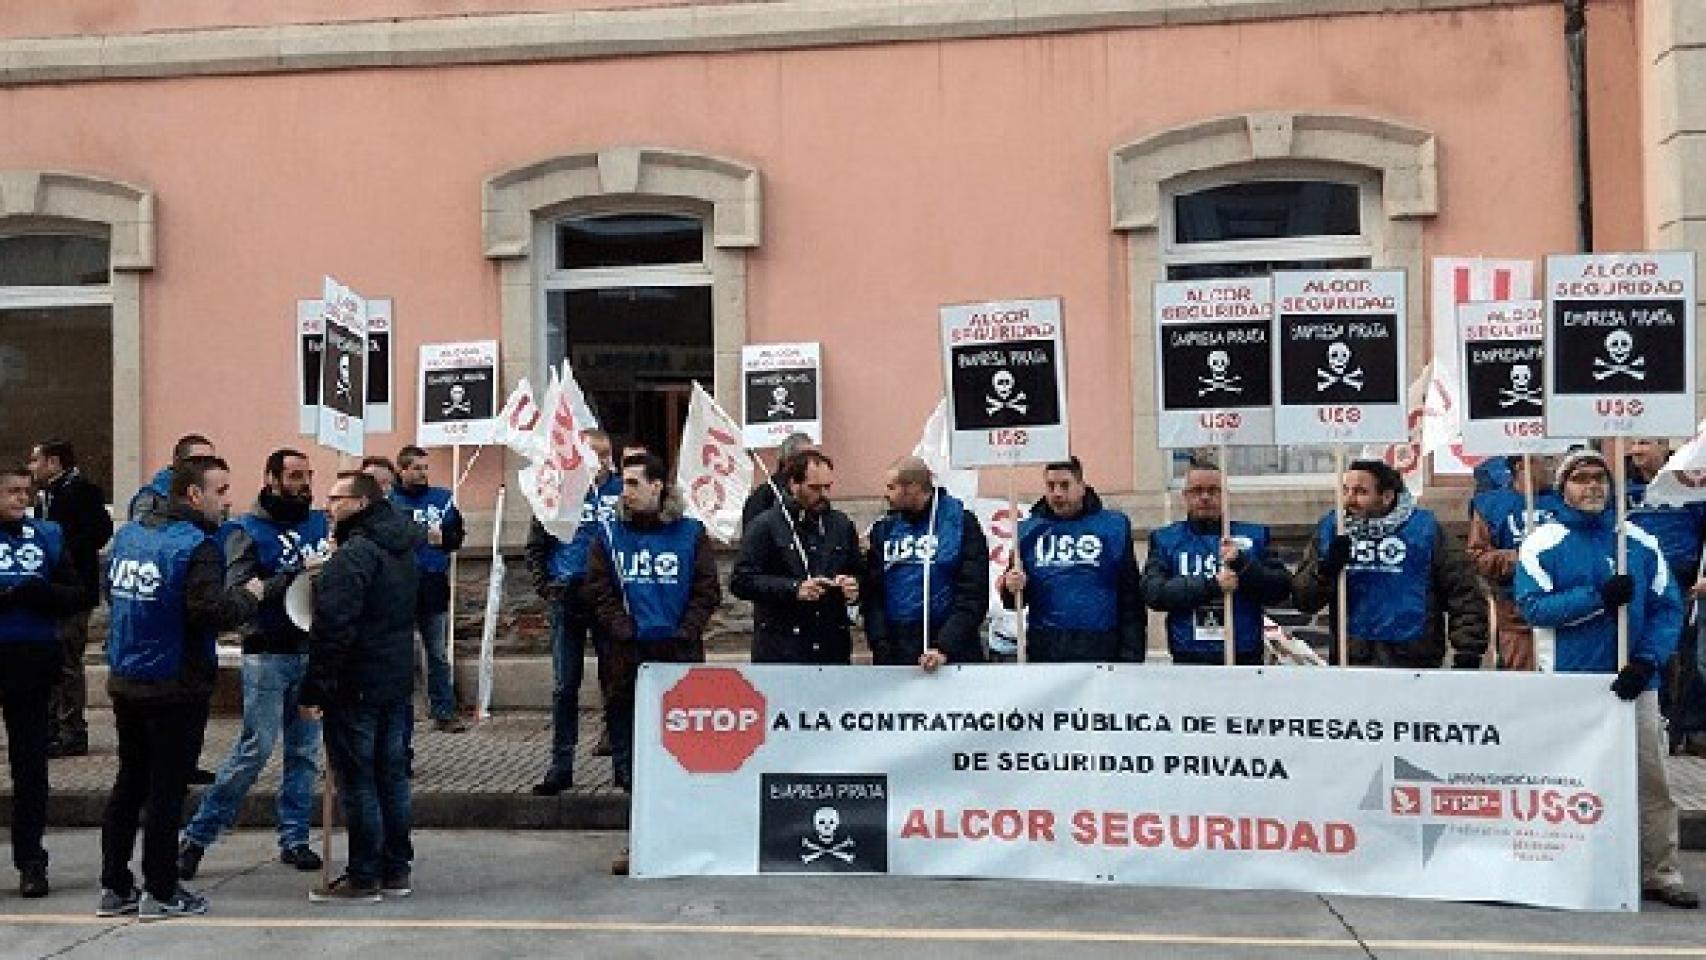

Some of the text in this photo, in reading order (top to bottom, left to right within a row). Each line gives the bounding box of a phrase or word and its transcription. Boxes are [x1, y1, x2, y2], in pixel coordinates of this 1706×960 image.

[1581, 263, 1659, 278] ALCOR
[1304, 280, 1372, 292] ALCOR
[1555, 280, 1684, 296] SEGURIDAD
[1187, 289, 1251, 302] ALCOR
[1162, 303, 1272, 320] SEGURIDAD
[1282, 297, 1395, 312] SEGURIDAD
[969, 309, 1029, 327] ALCOR
[1563, 308, 1676, 327] EMPRESA PIRATA
[952, 323, 1054, 340] SEGURIDAD
[1318, 407, 1361, 423] USO
[1595, 399, 1645, 416] USO
[1198, 413, 1242, 429] USO
[883, 534, 939, 562] USO
[1034, 534, 1103, 561] USO
[1351, 537, 1407, 563] SO
[1178, 551, 1218, 577] US
[665, 708, 1500, 745] STOP A LA CONTRATACIÓN PÚBLICA DE EMPRESAS PIRATA
[953, 752, 1288, 780] DE SEGURIDAD PRIVADA
[770, 783, 884, 800] EMPRESA PIRATA
[1510, 788, 1605, 825] USO
[901, 808, 1358, 854] ALCOR SEGURIDAD
